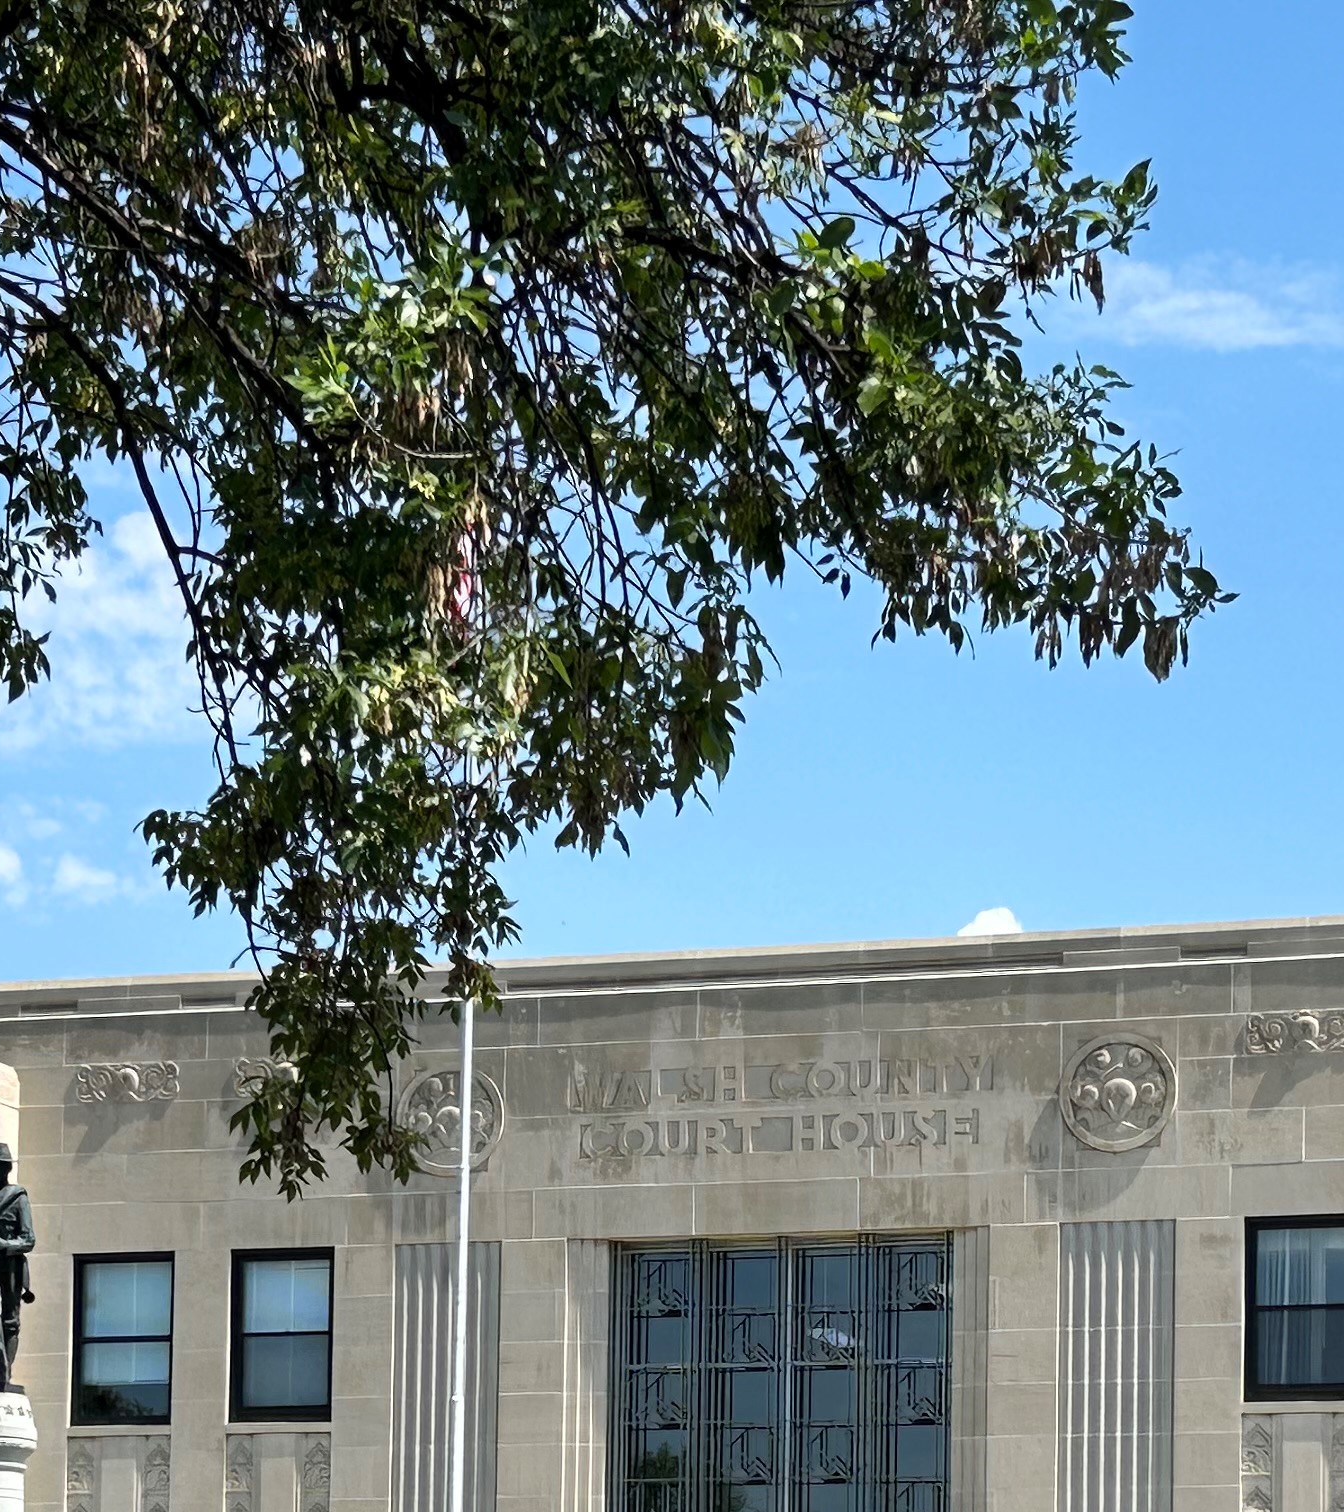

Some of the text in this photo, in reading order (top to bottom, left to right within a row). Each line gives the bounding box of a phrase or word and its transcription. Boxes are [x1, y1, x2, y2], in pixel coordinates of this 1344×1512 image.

[567, 1054, 993, 1113] WALSH COUNTY
[580, 1109, 979, 1159] COURT HOUSE
